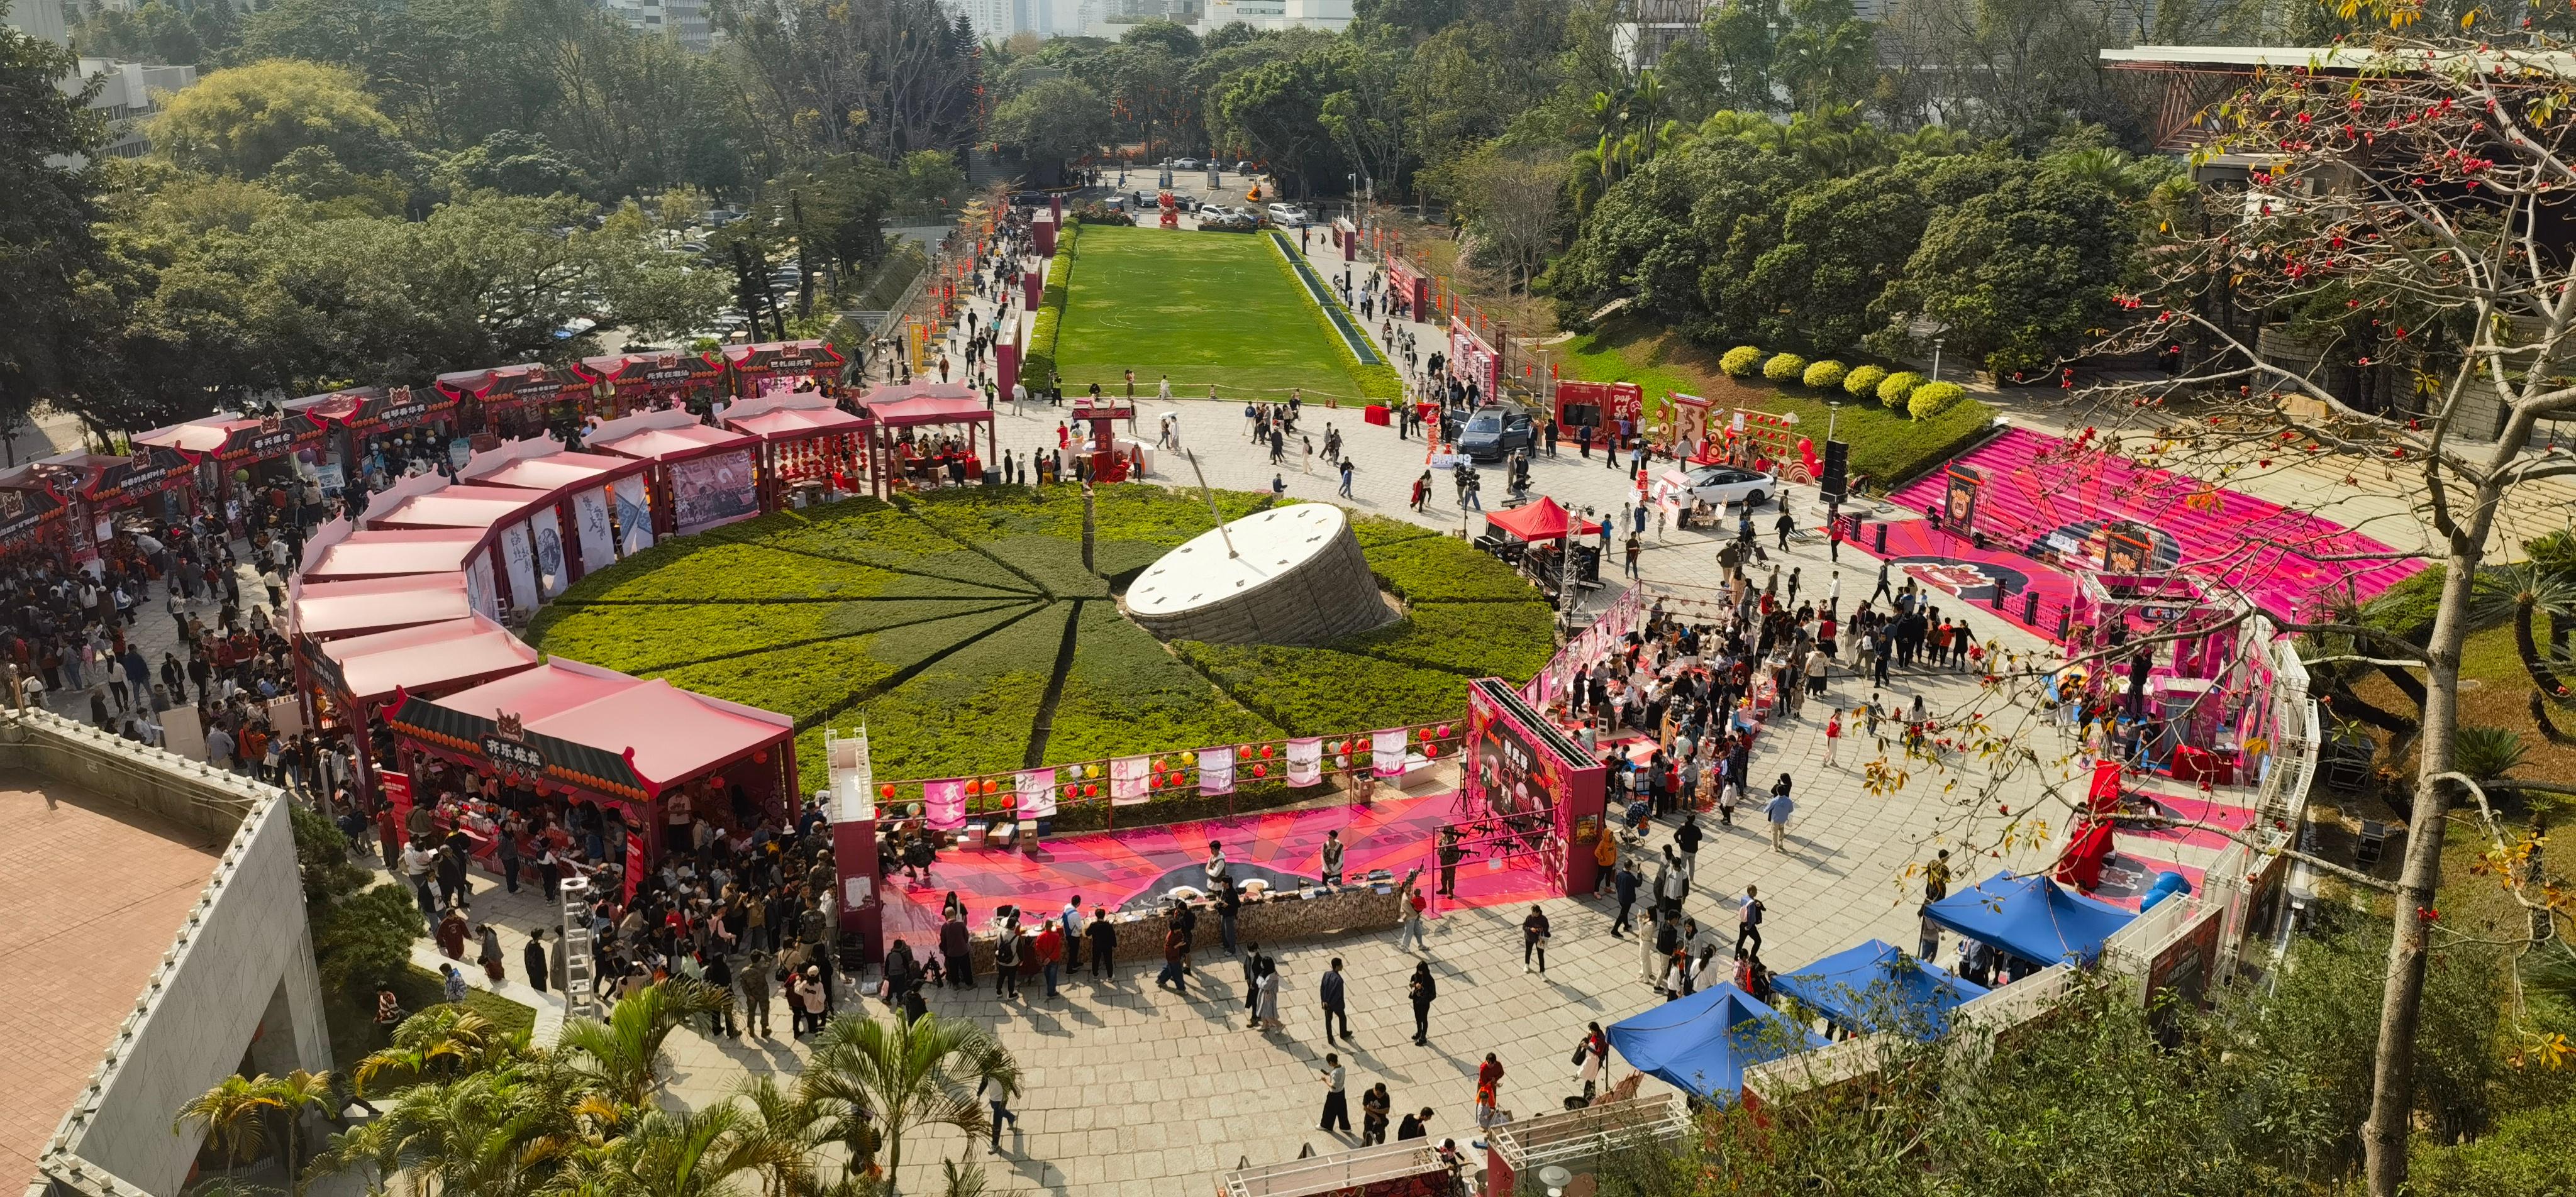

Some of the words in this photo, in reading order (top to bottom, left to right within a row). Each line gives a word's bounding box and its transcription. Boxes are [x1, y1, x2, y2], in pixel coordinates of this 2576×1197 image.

[770, 359, 813, 368] 巴扎闹元宵
[1099, 434, 1107, 449] 元宵
[121, 468, 166, 488] 新春的美好时光
[487, 739, 541, 766] 齐乐龙龙
[943, 782, 962, 819] 武术
